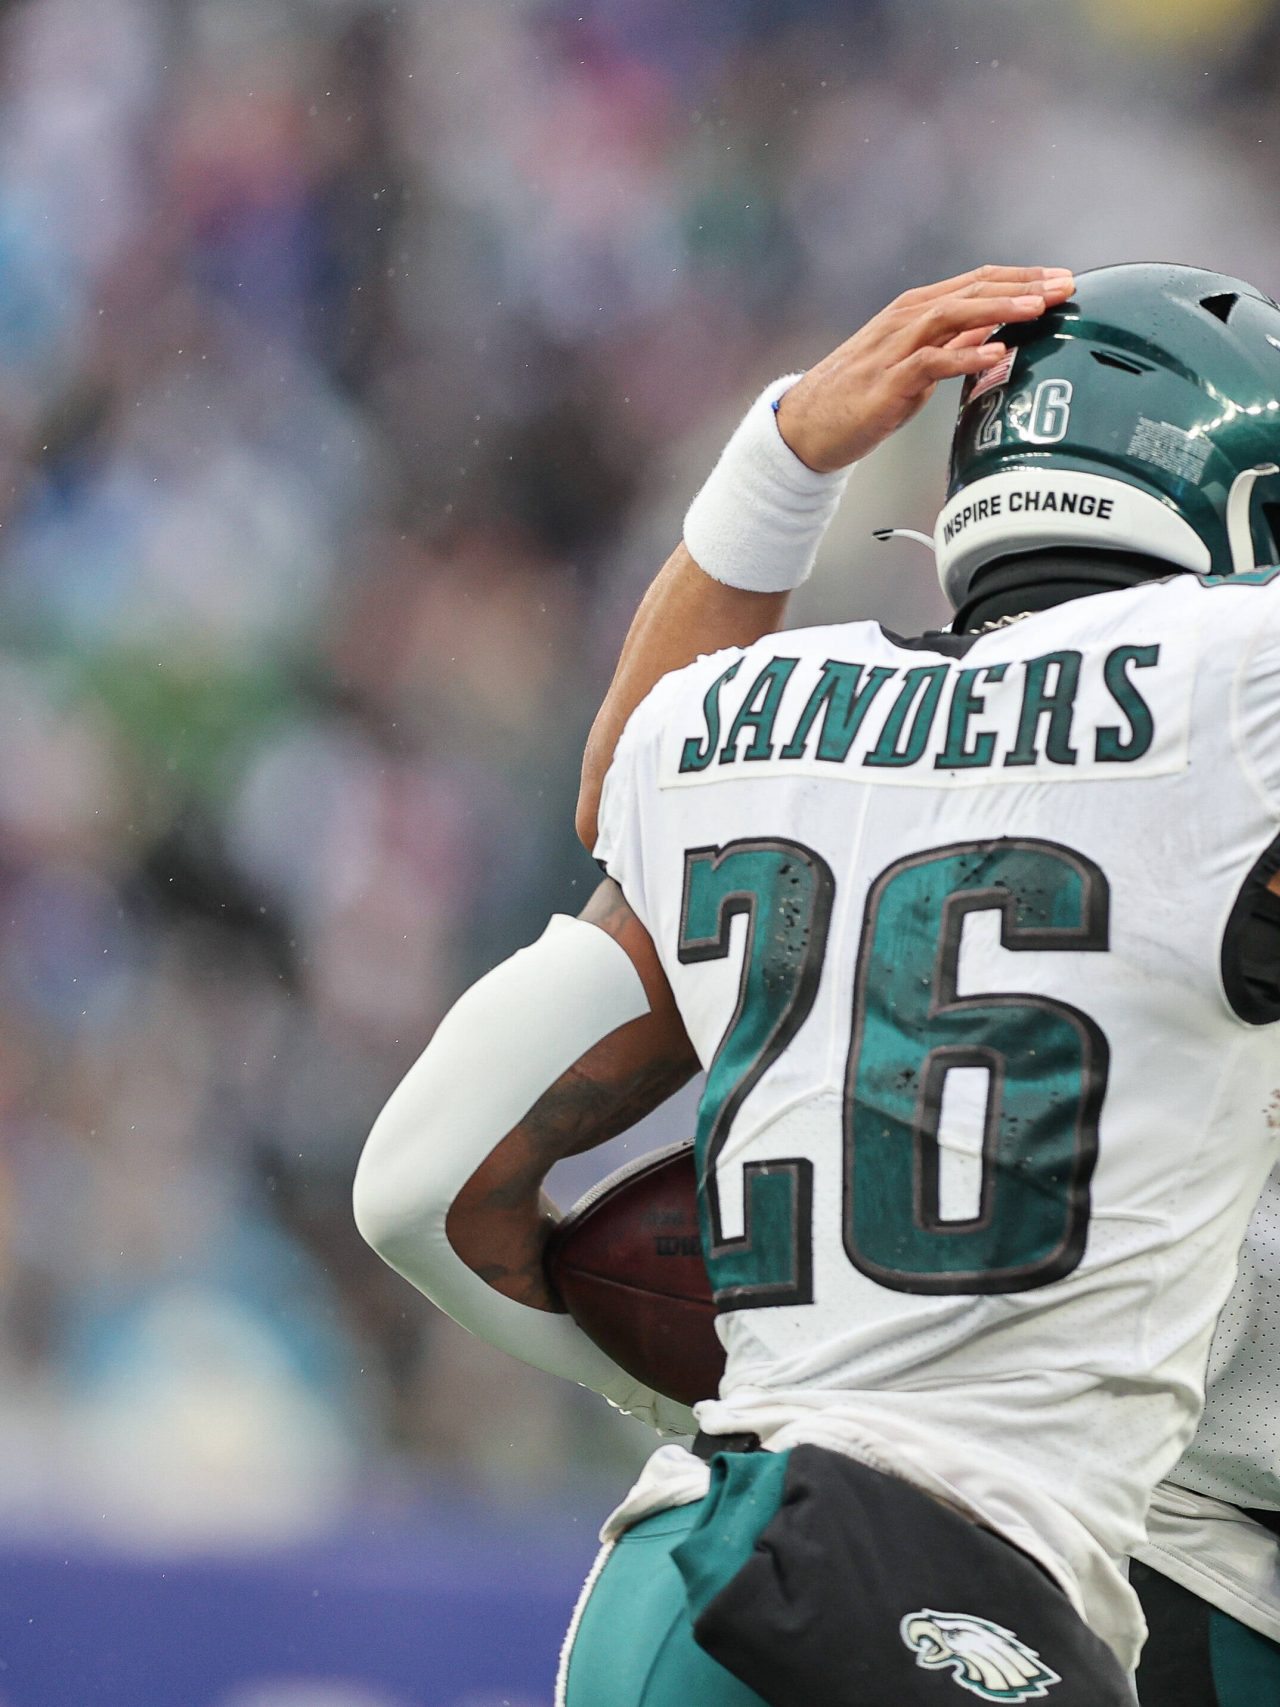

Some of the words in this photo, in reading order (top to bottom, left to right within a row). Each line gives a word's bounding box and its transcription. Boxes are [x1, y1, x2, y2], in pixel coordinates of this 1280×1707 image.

[943, 494, 1001, 545] INSPIRE
[1009, 491, 1114, 520] CHANGE
[678, 644, 1160, 773] SANDERS
[678, 836, 1111, 1310] 26
